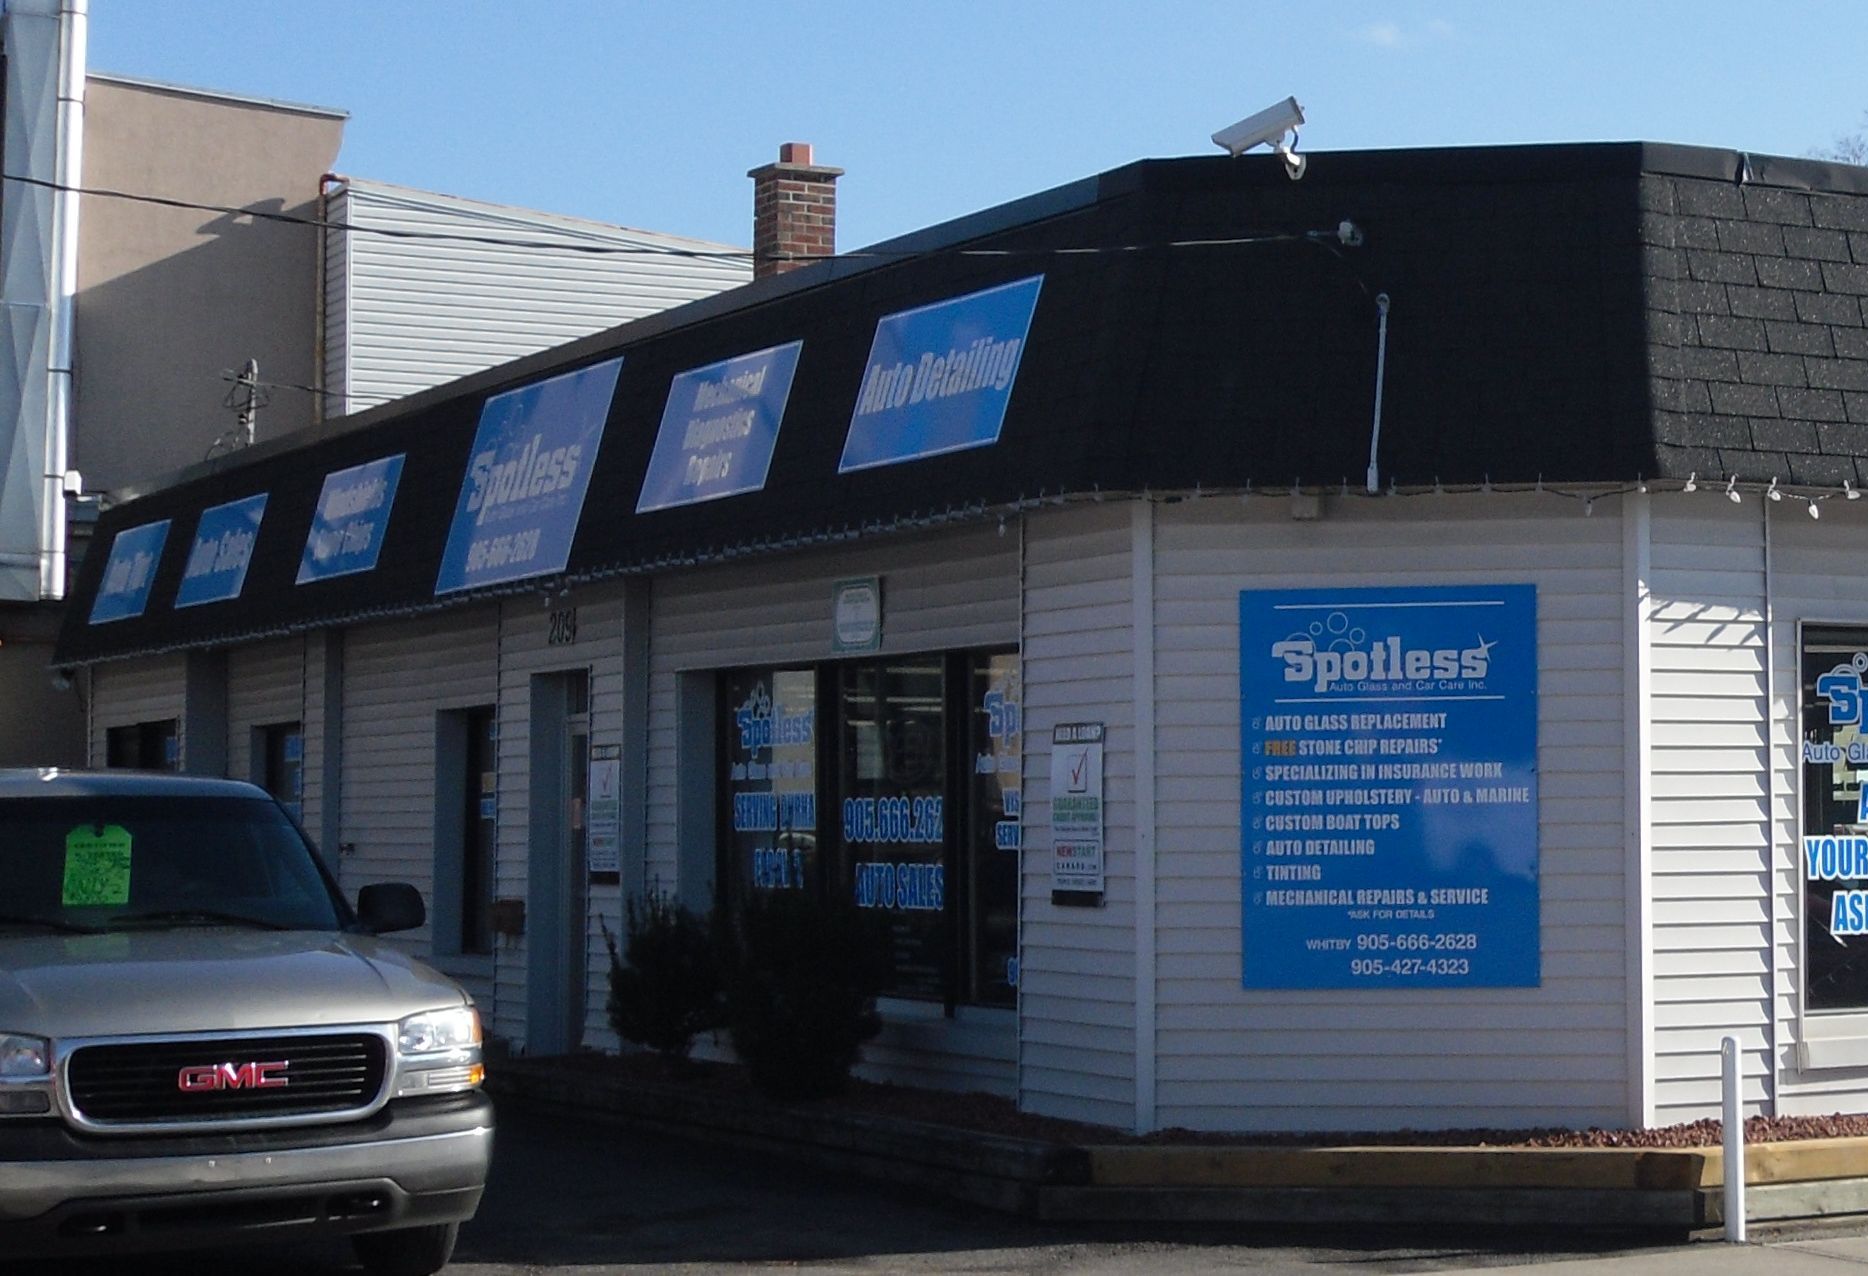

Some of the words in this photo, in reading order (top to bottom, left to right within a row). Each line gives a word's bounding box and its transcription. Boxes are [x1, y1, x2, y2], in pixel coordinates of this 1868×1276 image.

[858, 363, 915, 415] Auto
[912, 336, 1021, 405] Detailing
[467, 433, 582, 526] Spotless
[1271, 636, 1488, 693] Spotless
[1329, 682, 1354, 692] Auto
[1356, 682, 1387, 692] Glass
[1392, 681, 1411, 691] and
[1416, 681, 1435, 690] Car
[1439, 681, 1464, 690] Care
[1468, 680, 1488, 690] Inc.
[737, 704, 814, 759] Spotless
[1265, 715, 1302, 732] AUTO
[1305, 714, 1348, 731] GLASS
[1351, 713, 1448, 731] REPLACEMENT
[1264, 740, 1297, 757] FREE
[1299, 740, 1341, 755] STONE
[1344, 739, 1377, 754] CHIP
[1802, 741, 1842, 764] Auto
[1265, 764, 1359, 781] SPECIALIZING
[1361, 764, 1375, 780] IN
[1378, 763, 1457, 779] INSURANCE
[1459, 762, 1503, 778] WORK
[1265, 790, 1323, 806] CUSTOM
[1326, 789, 1412, 805] UPHOLSTERY
[1423, 788, 1460, 804] AUTO
[1463, 790, 1473, 803] &
[1476, 787, 1530, 803] MARINE
[844, 796, 944, 843] 905.666.262
[1265, 815, 1323, 831] CUSTOM
[1326, 814, 1361, 830] BOAT
[1364, 814, 1400, 830] TOPS
[1266, 840, 1303, 856] AUTO
[1305, 839, 1376, 855] DETAILING
[1266, 865, 1322, 881] TINTING
[856, 862, 896, 909] AUTO
[896, 862, 944, 911] SALES
[1266, 889, 1354, 906] MECHANICAL
[1356, 889, 1415, 905] REPAIRS
[1417, 890, 1428, 904] &
[1430, 888, 1489, 904] SERVICE
[1373, 910, 1393, 920] FOR
[1395, 909, 1435, 920] DETAILS
[1305, 938, 1351, 951] WHITBY
[1357, 934, 1478, 951] 905-666-2628
[1351, 958, 1470, 976] 905-427-4323
[178, 1060, 290, 1093] GMC
